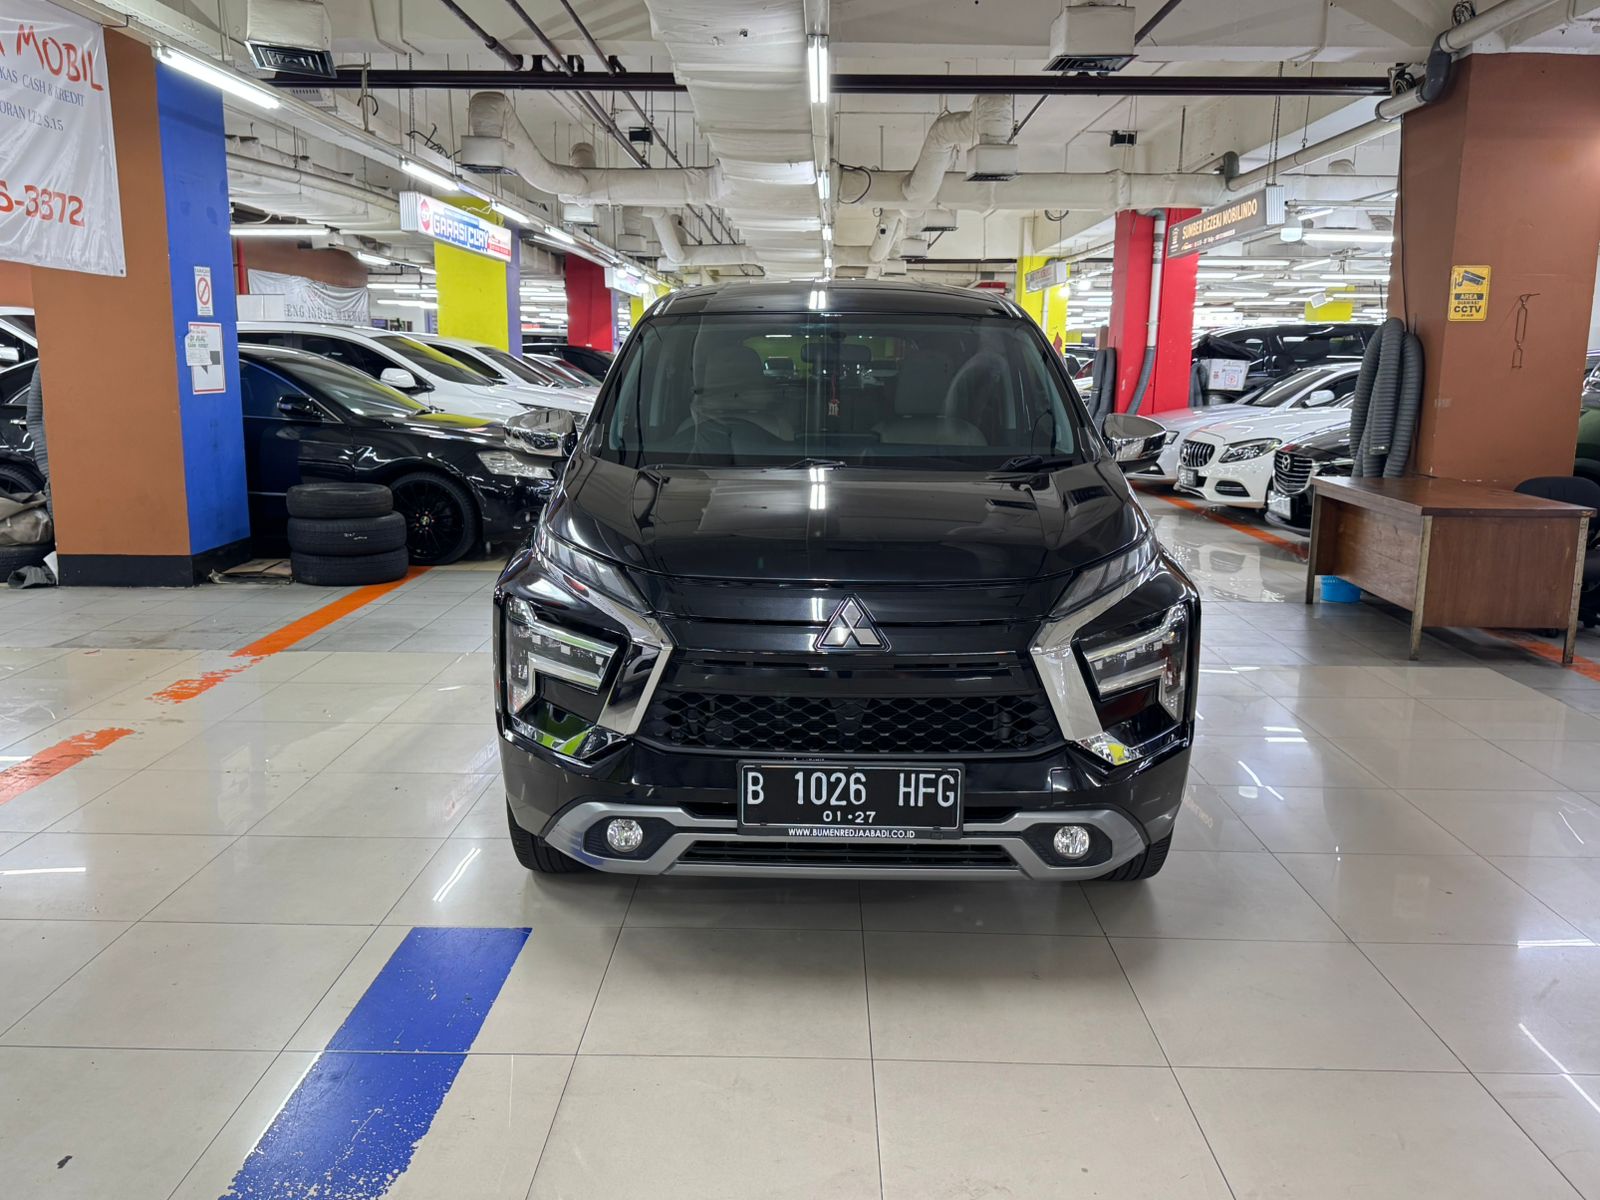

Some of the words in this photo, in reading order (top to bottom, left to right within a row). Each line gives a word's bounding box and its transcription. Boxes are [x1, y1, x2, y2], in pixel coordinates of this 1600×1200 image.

[17, 24, 104, 92] MOBIL
[22, 74, 46, 94] CASH
[55, 86, 85, 107] KREDIT
[1222, 198, 1258, 226] MOBILINDO
[1454, 305, 1482, 313] CCTV
[747, 771, 764, 805] B
[794, 771, 867, 806] 1026
[898, 772, 955, 807] HFG
[788, 827, 915, 839] WWW.BUMENREDJAABADI.CO.ID
